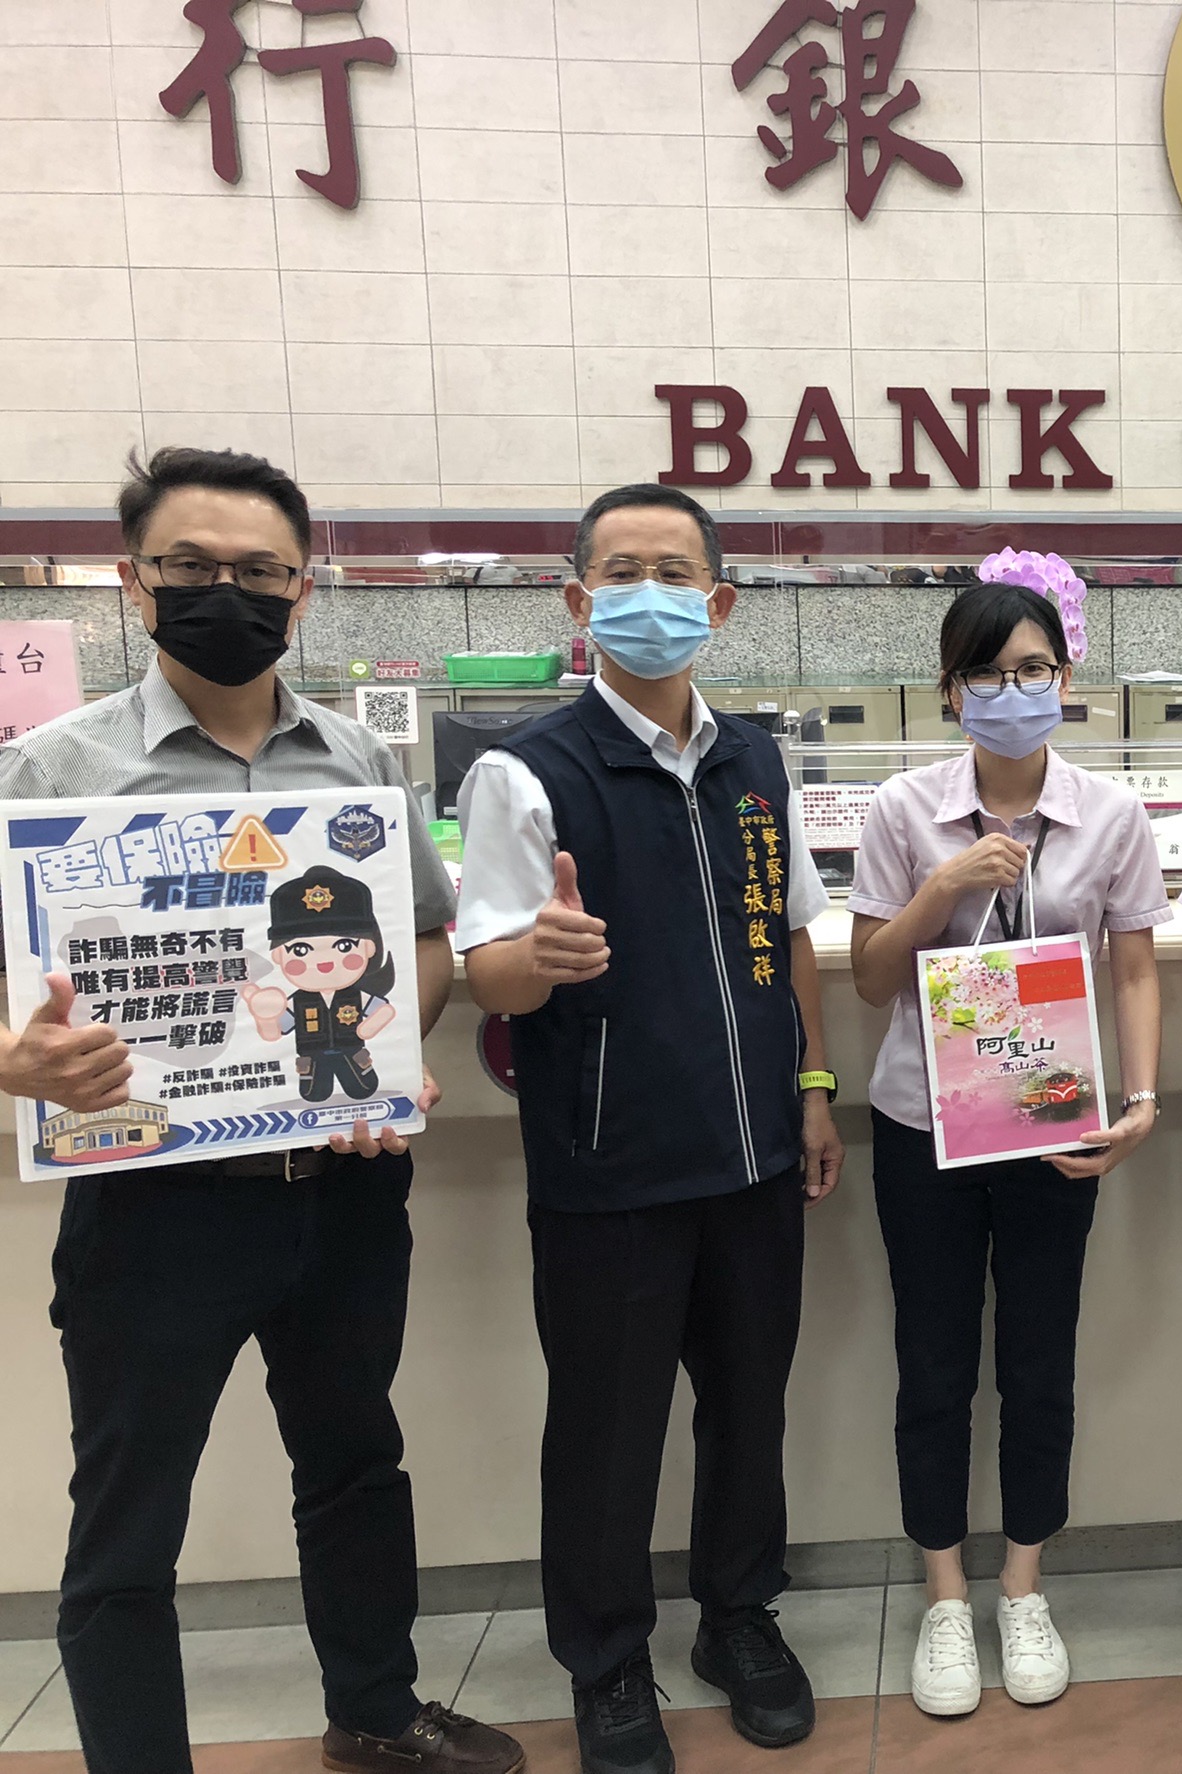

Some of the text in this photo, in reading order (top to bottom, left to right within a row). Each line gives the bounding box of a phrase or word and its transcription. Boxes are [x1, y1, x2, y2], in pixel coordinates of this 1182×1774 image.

[654, 385, 1113, 489] BANK
[1112, 776, 1169, 789] 票存款
[762, 827, 784, 916] 警察局
[140, 870, 268, 912] 不冒險
[68, 928, 245, 965] 詐騙無奇不有
[71, 957, 249, 995] 唯有提高警覺
[91, 989, 238, 1024] 才能將謊言
[976, 1036, 1056, 1059] 阿里山
